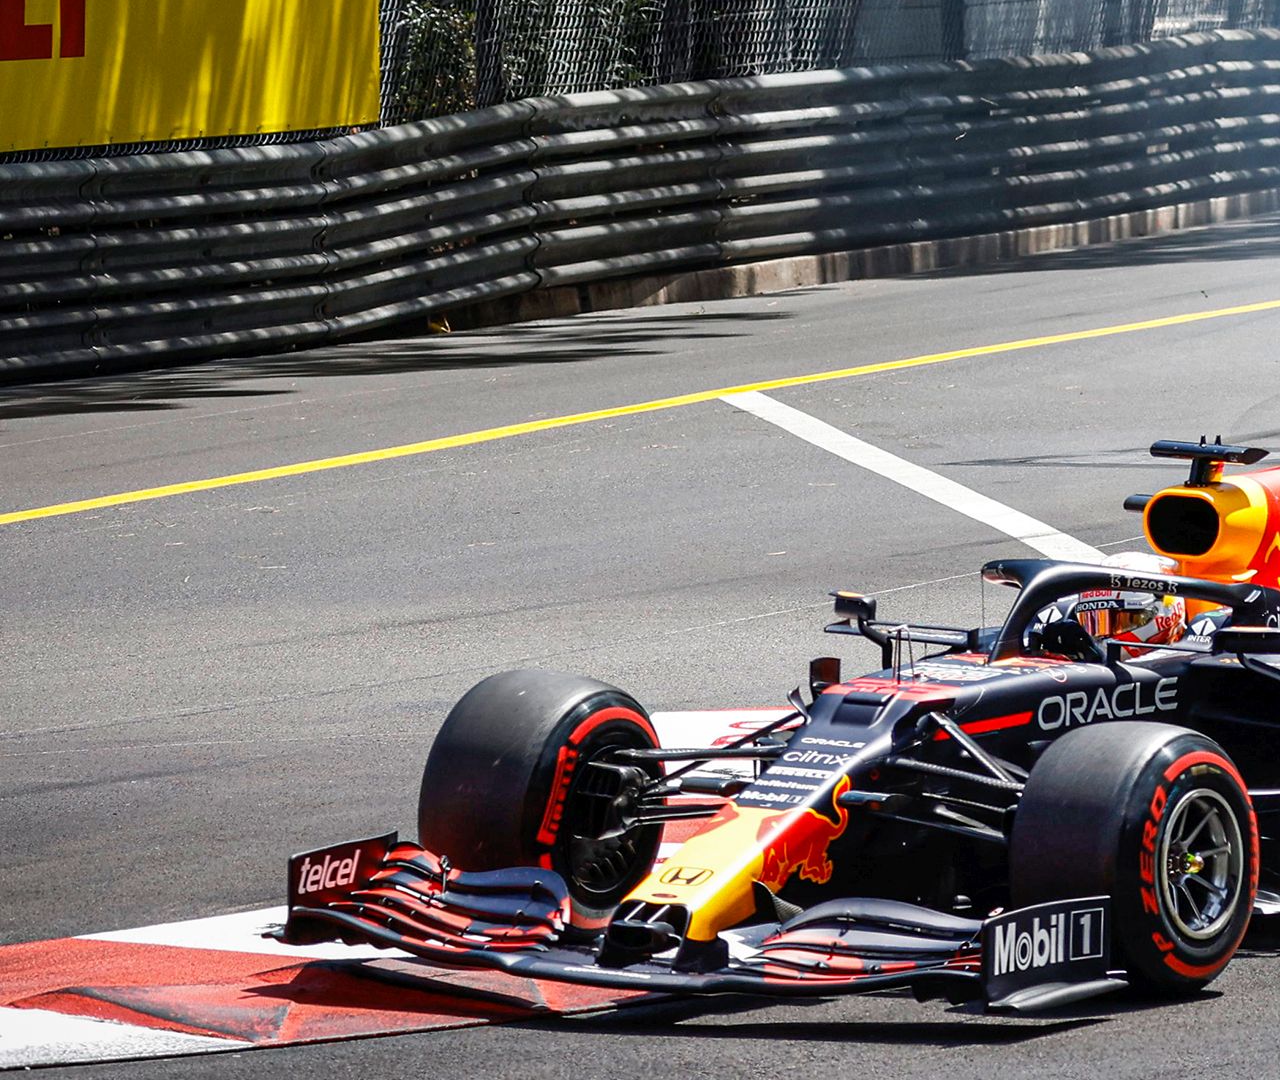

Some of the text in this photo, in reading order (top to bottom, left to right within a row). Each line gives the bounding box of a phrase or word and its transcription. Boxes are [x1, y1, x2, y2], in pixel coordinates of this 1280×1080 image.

[1125, 575, 1165, 592] Tezos
[1077, 600, 1120, 612] HONDA
[1186, 634, 1213, 644] INTER
[1037, 676, 1179, 731] ORACLE
[801, 736, 866, 748] ORACLE
[782, 749, 853, 766] citrix
[739, 790, 788, 803] Mobil
[1139, 784, 1168, 916] ZERO
[297, 848, 362, 895] telcel
[993, 913, 1066, 977] Mobil
